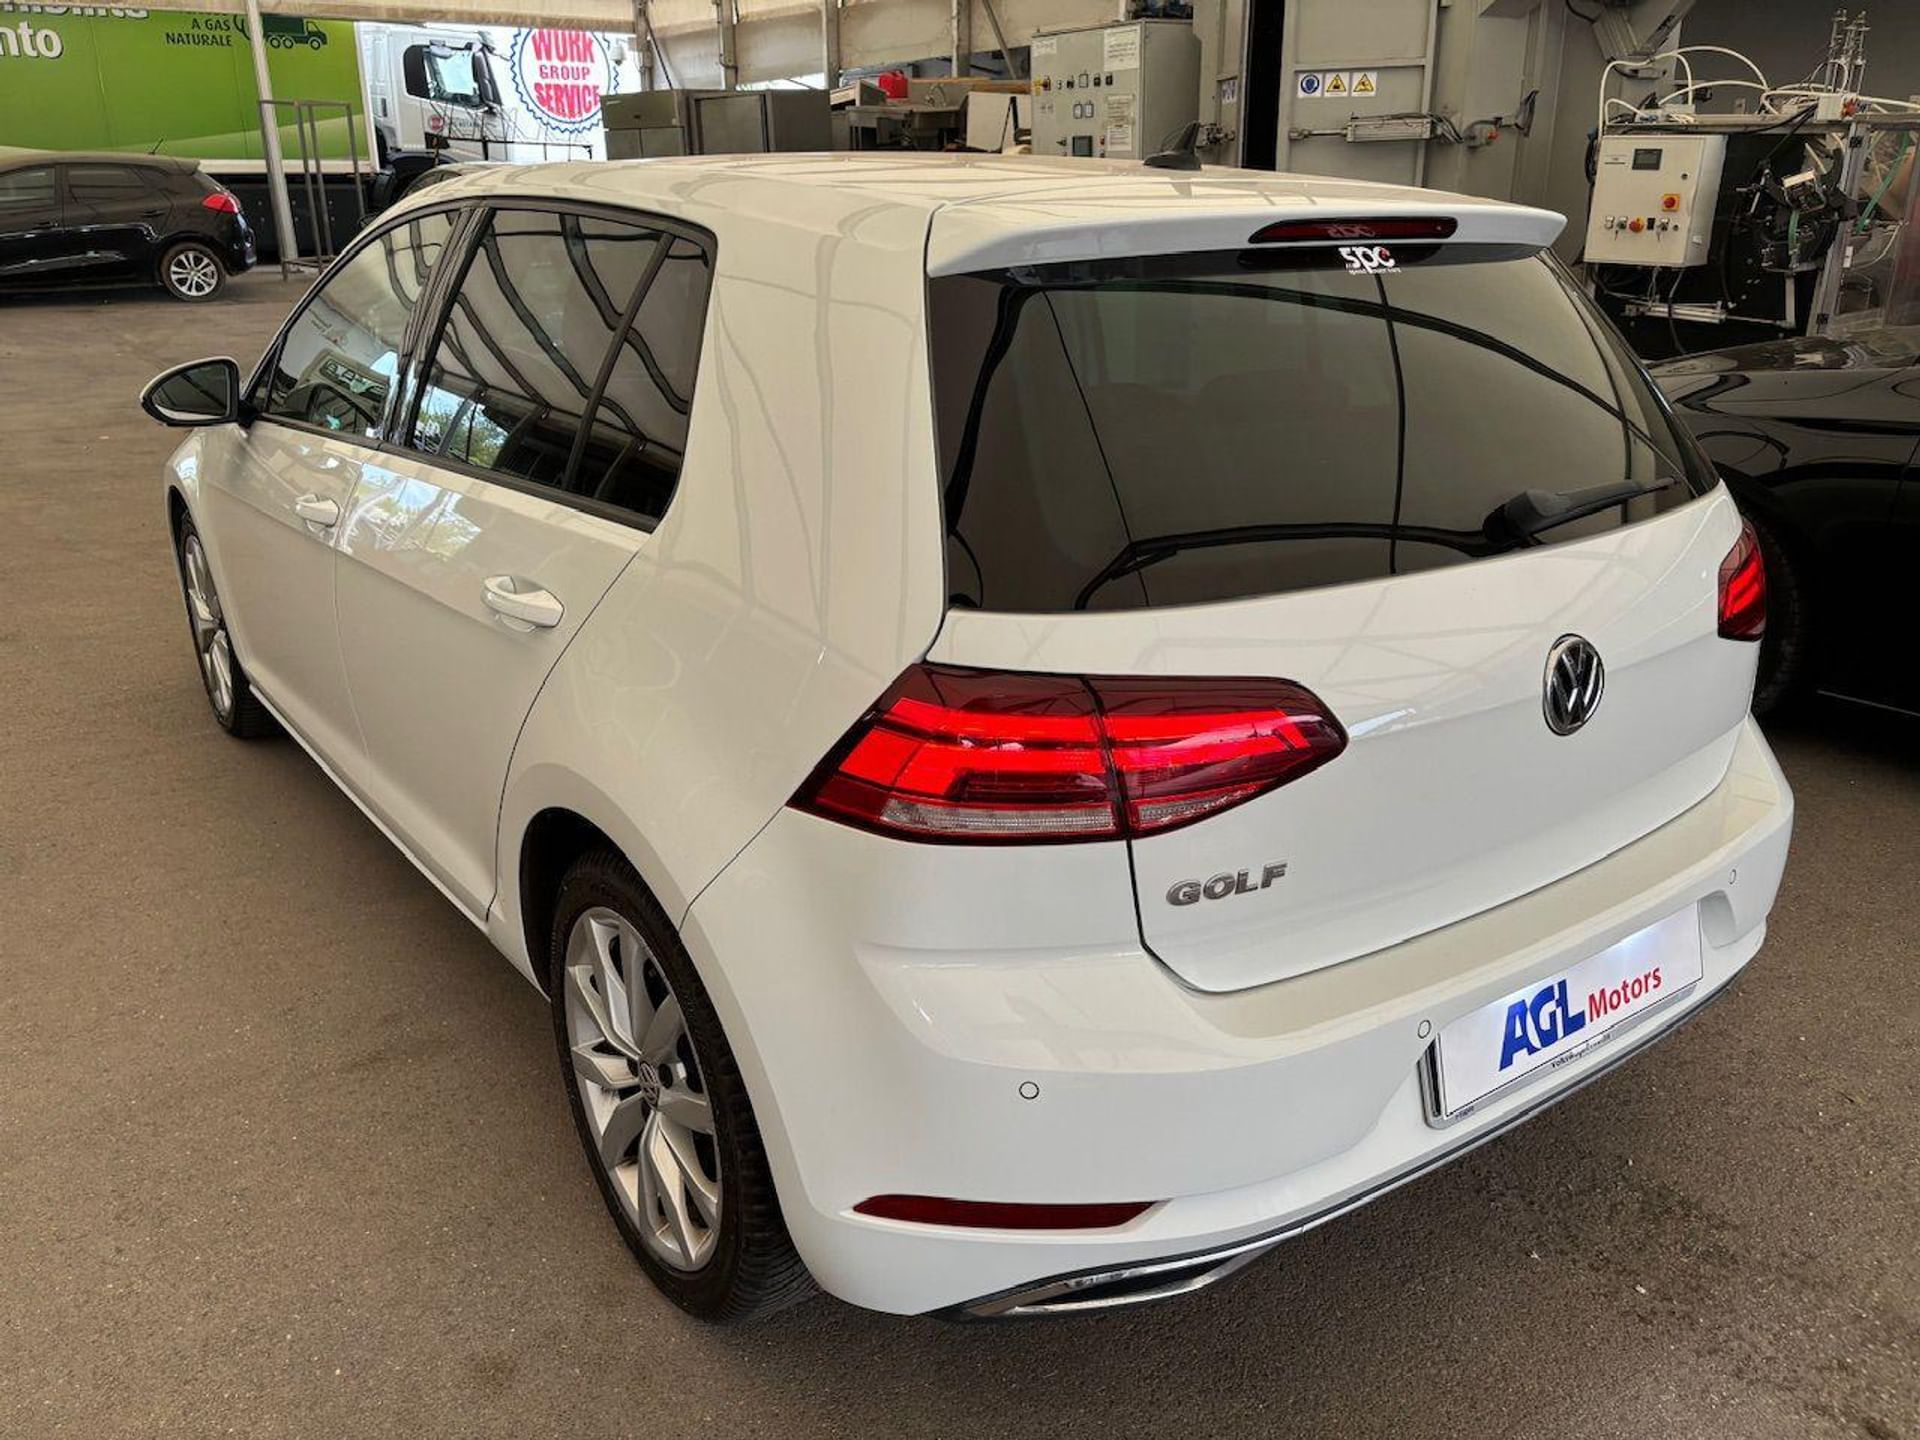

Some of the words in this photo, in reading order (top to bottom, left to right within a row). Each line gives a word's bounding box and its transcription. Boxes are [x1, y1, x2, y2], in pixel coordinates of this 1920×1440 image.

[191, 17, 201, 30] A
[205, 18, 231, 31] GAS
[165, 32, 232, 47] NATURALE
[540, 64, 590, 80] GROUP
[534, 82, 600, 118] SERVICE
[1165, 860, 1288, 907] GOLF
[1498, 978, 1586, 1072] AGL
[1588, 967, 1662, 1022] Motors
